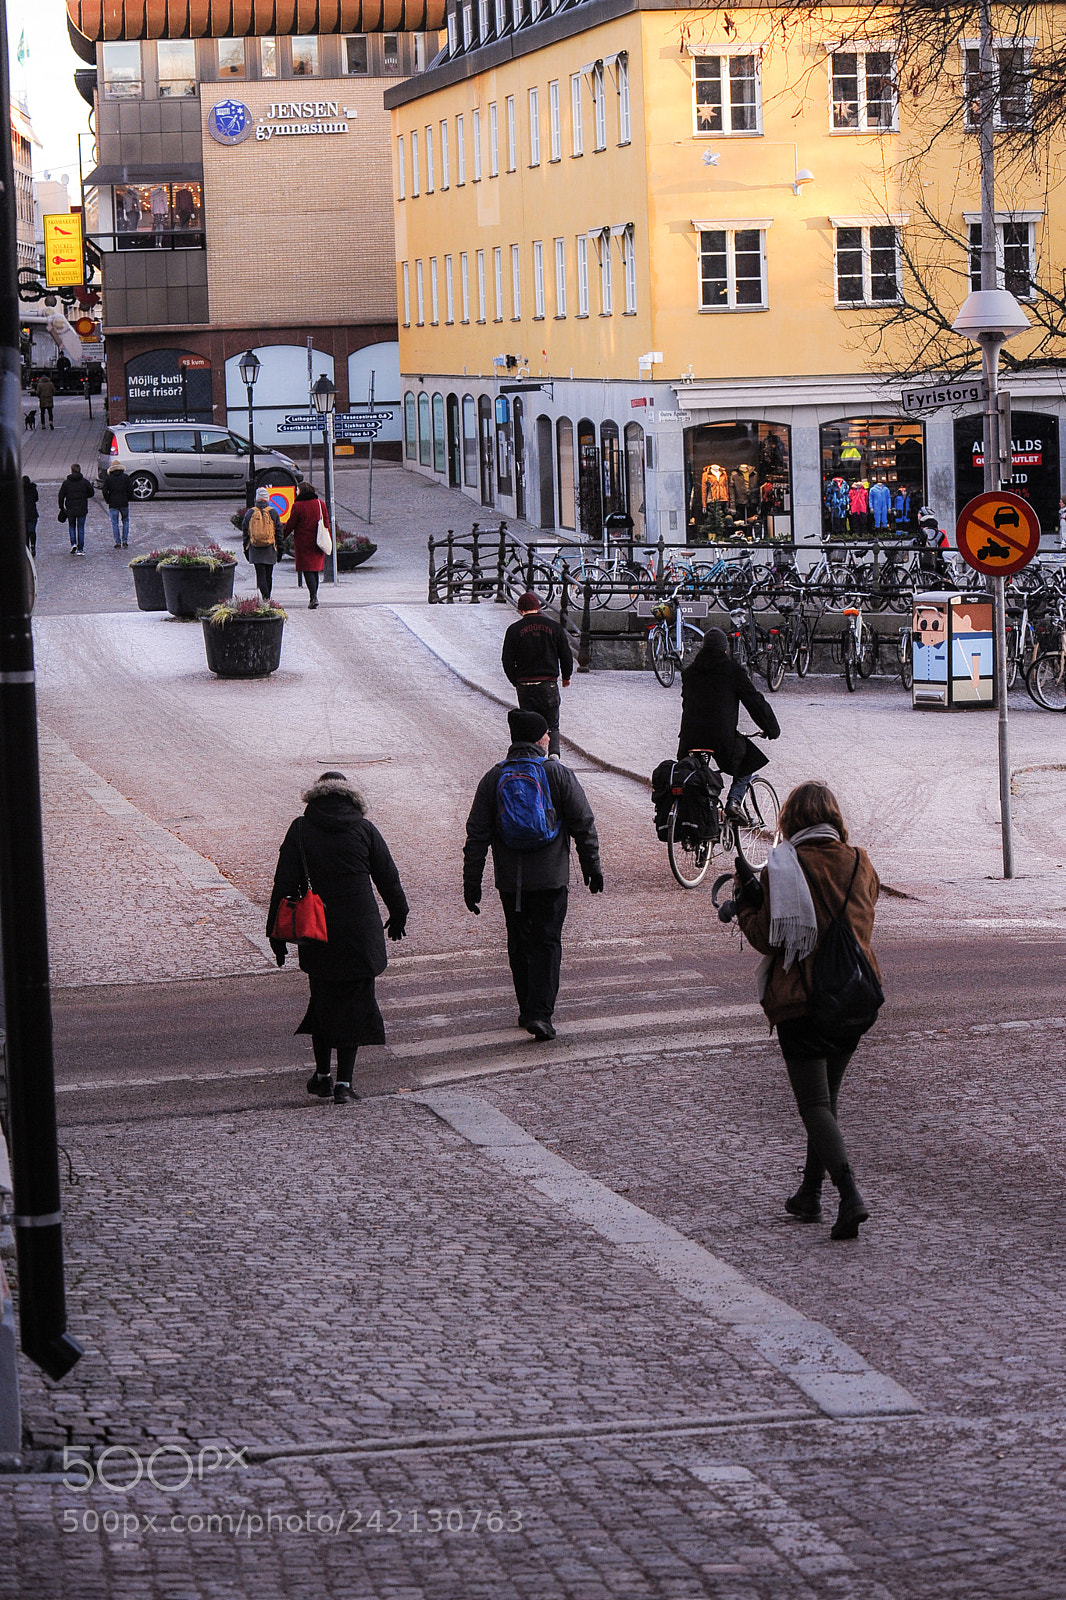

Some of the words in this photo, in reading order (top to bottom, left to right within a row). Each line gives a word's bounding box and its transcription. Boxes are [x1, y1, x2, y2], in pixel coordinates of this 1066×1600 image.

[266, 102, 339, 119] JENSEN
[256, 119, 349, 140] gymnasium
[128, 375, 159, 386] Möjlig
[128, 388, 151, 398] Eller
[152, 386, 183, 397] frisör?
[906, 387, 979, 407] Fyristorg
